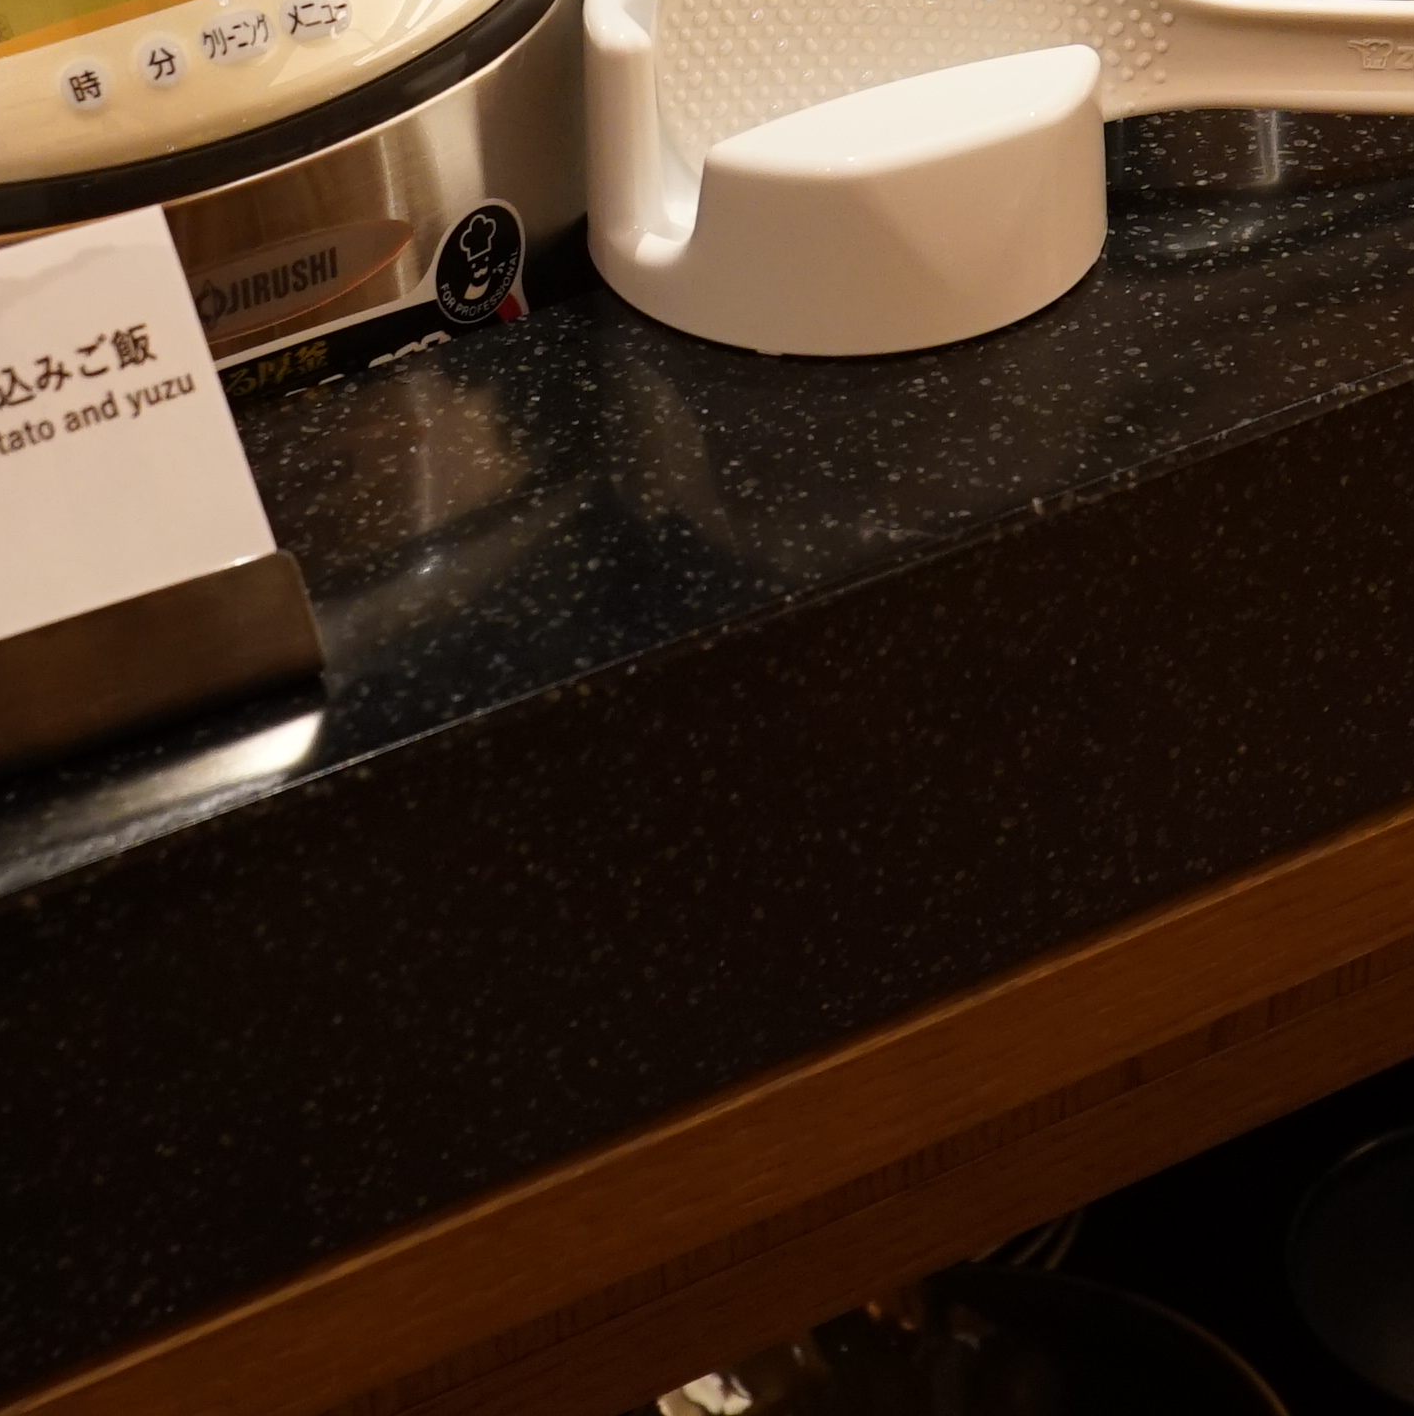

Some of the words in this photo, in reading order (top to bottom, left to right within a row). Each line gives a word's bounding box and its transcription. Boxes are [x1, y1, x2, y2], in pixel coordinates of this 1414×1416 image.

[202, 13, 270, 60] クリーニング
[288, 2, 348, 35] メニュー
[68, 70, 102, 103] 時
[147, 47, 176, 81] 分
[194, 246, 340, 330] OJIRUSHI
[440, 283, 457, 309] FOR
[454, 246, 519, 317] PROFESSIONAL
[64, 393, 120, 435] and
[125, 372, 197, 418] yuzu
